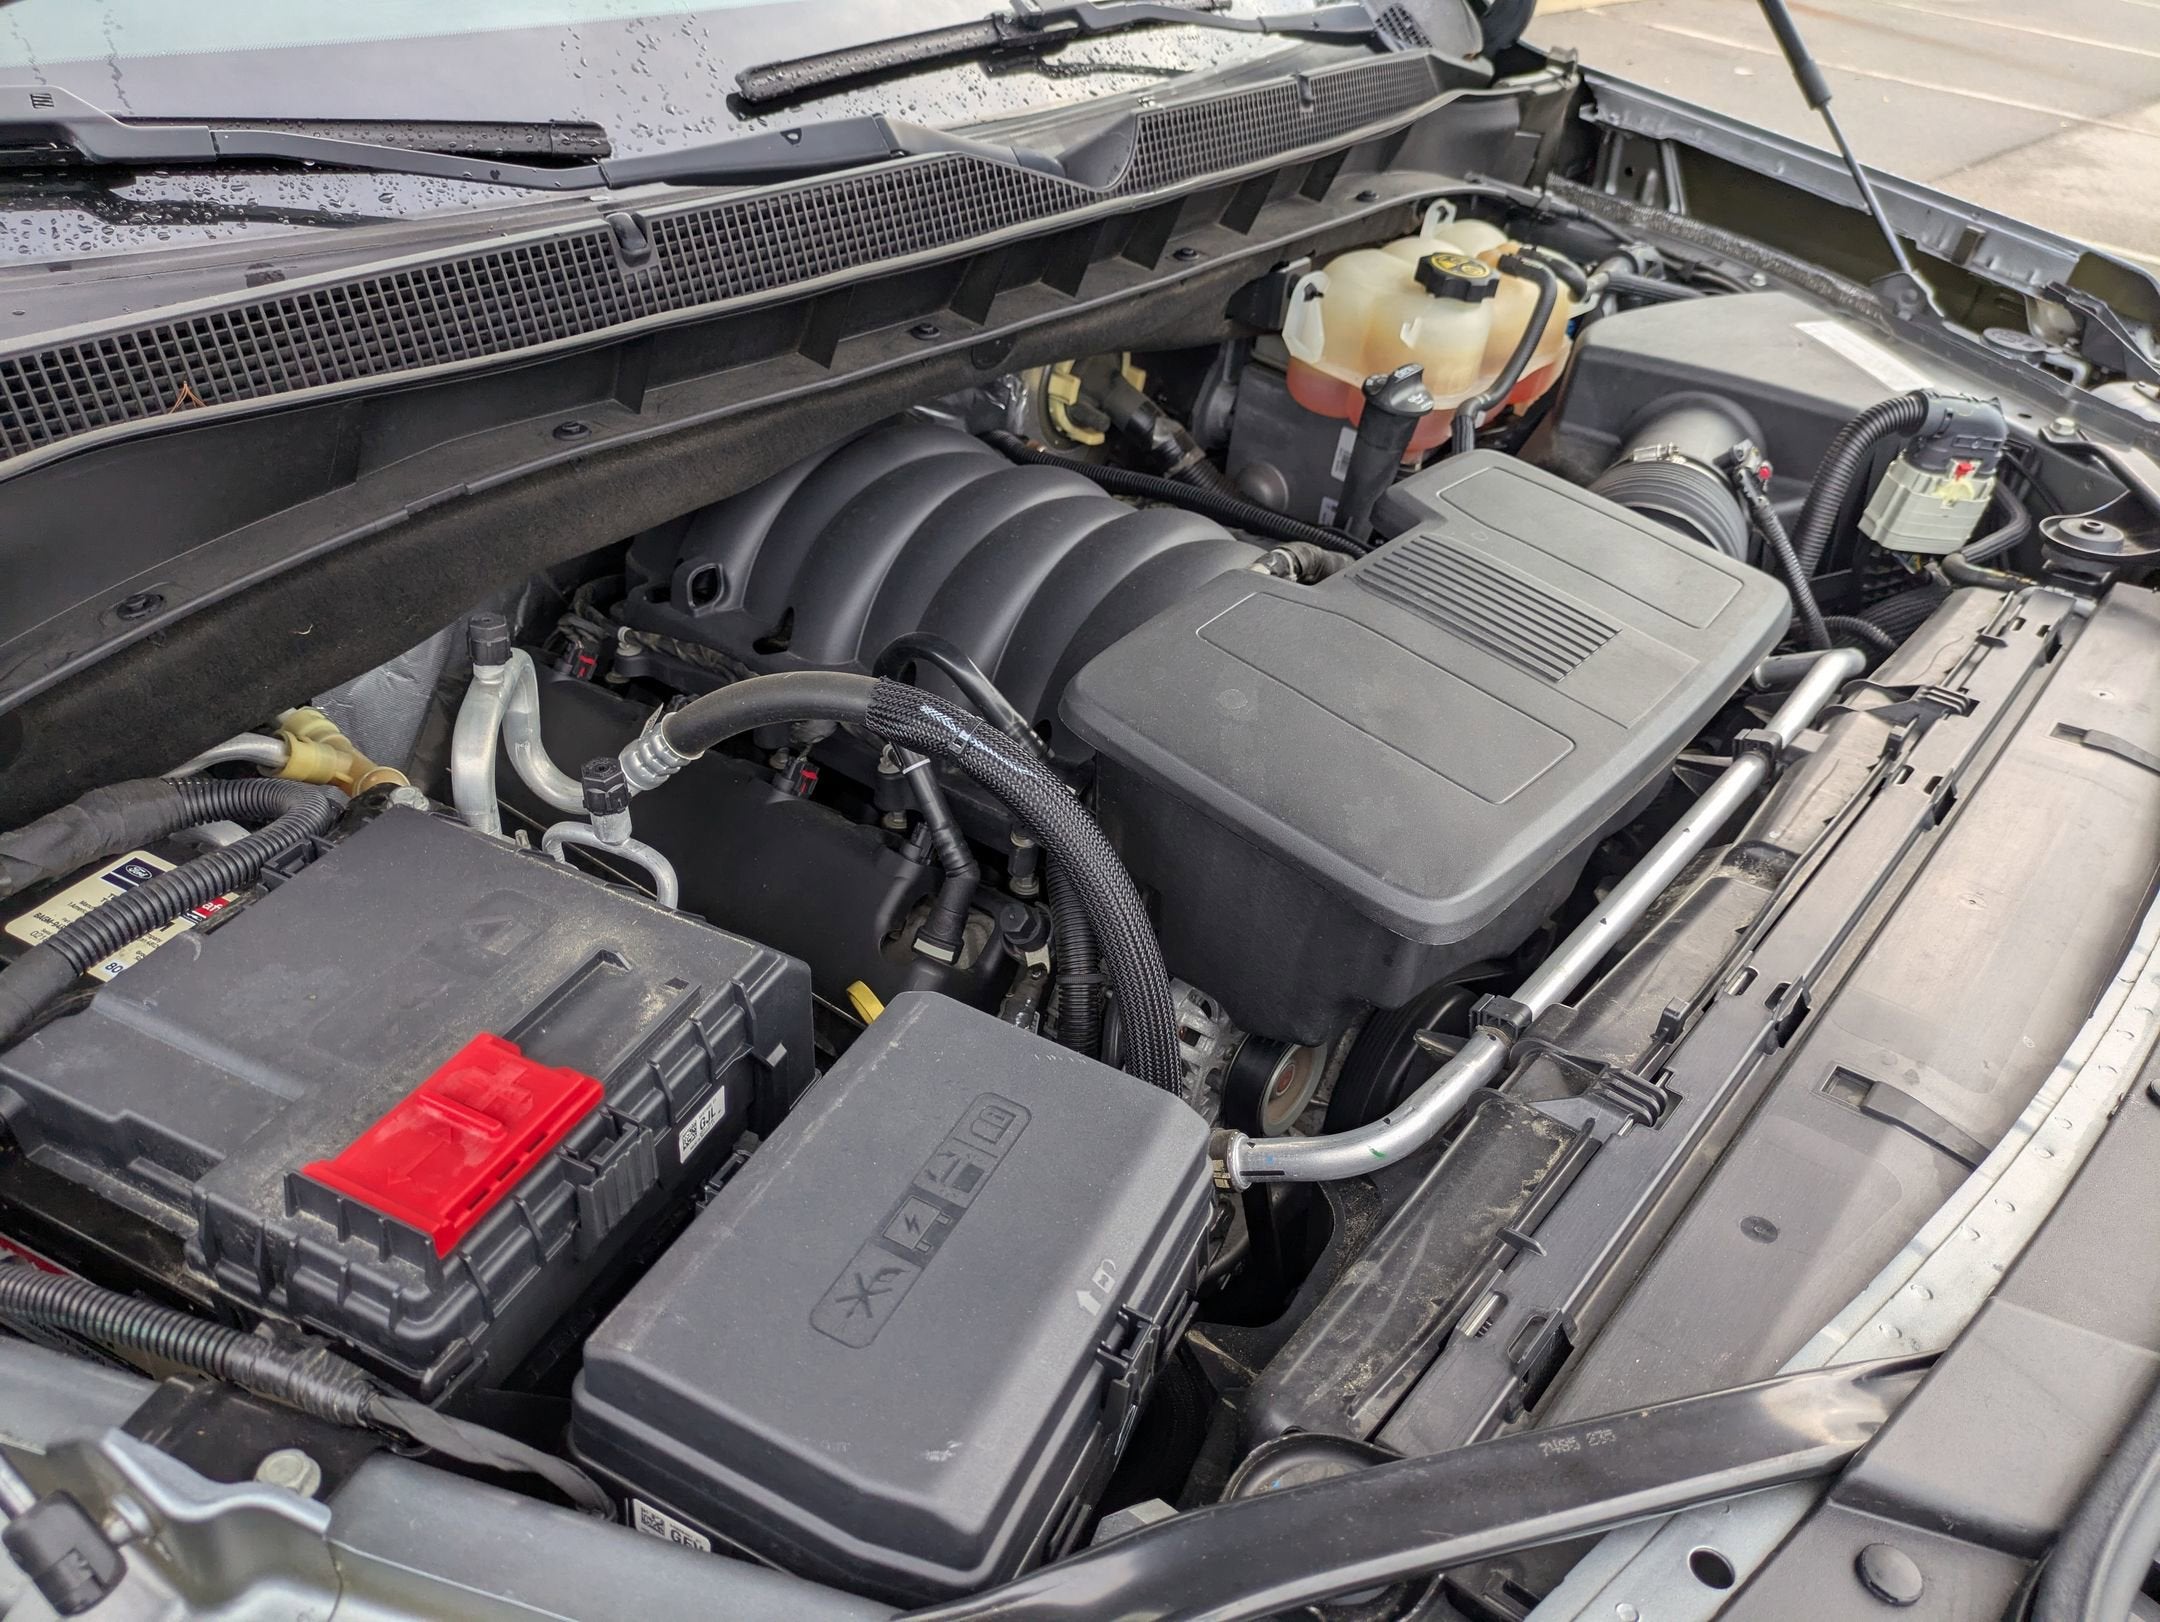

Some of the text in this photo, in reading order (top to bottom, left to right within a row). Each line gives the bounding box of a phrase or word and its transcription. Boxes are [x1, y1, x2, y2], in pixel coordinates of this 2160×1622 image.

[127, 865, 151, 878] Ford
[105, 962, 124, 974] 80
[700, 1106, 716, 1130] GJL
